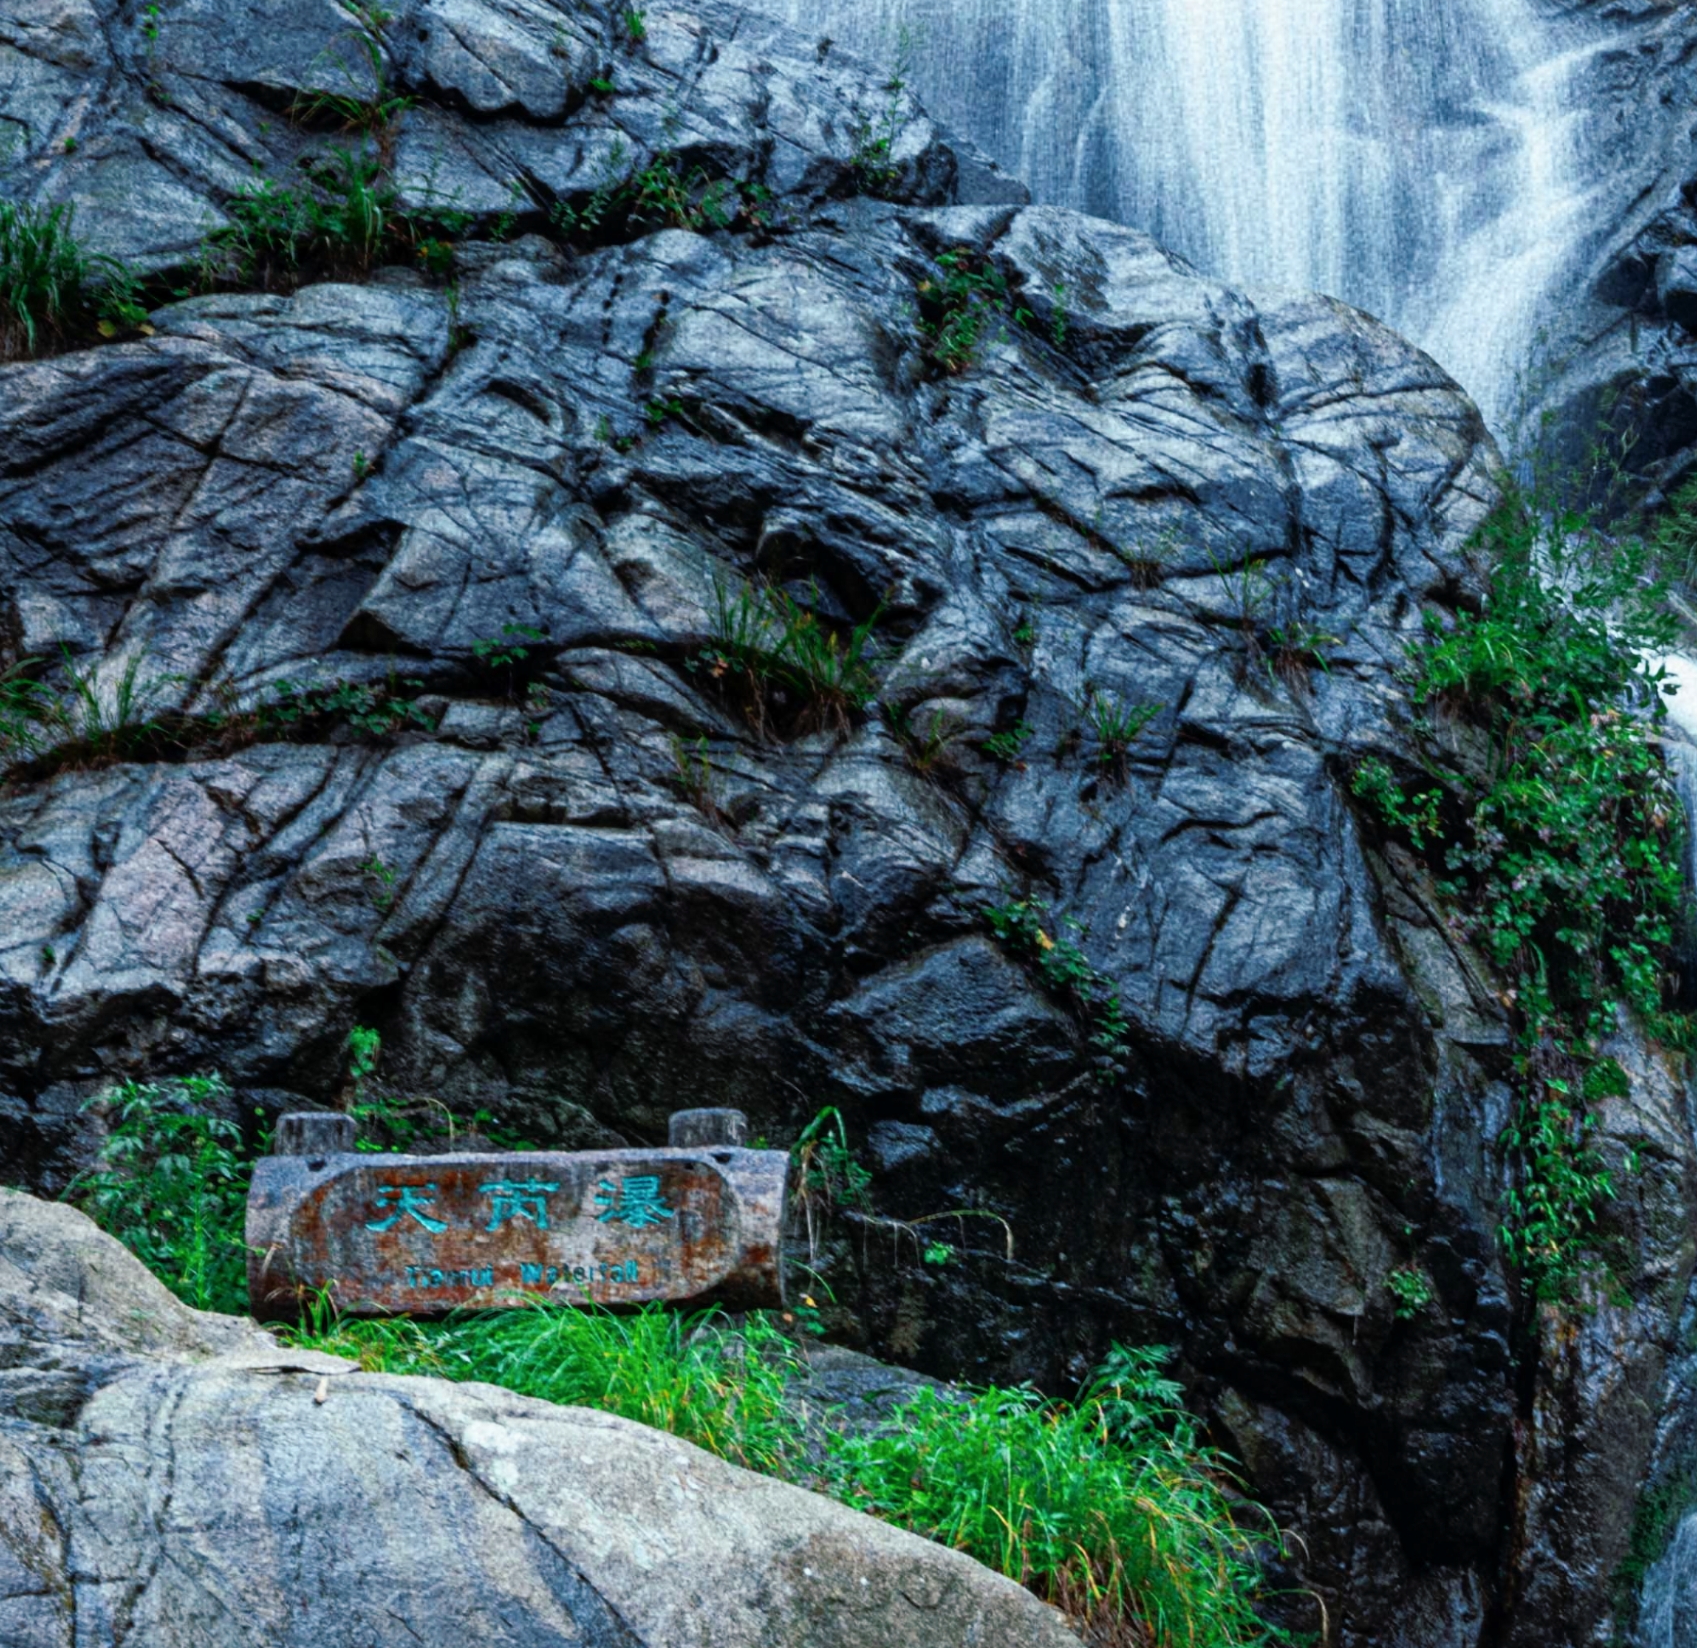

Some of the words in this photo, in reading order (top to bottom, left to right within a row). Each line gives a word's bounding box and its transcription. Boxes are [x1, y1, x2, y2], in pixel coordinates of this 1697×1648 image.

[364, 1175, 676, 1233] 天芮瀑
[519, 1259, 639, 1285] Waterfall
